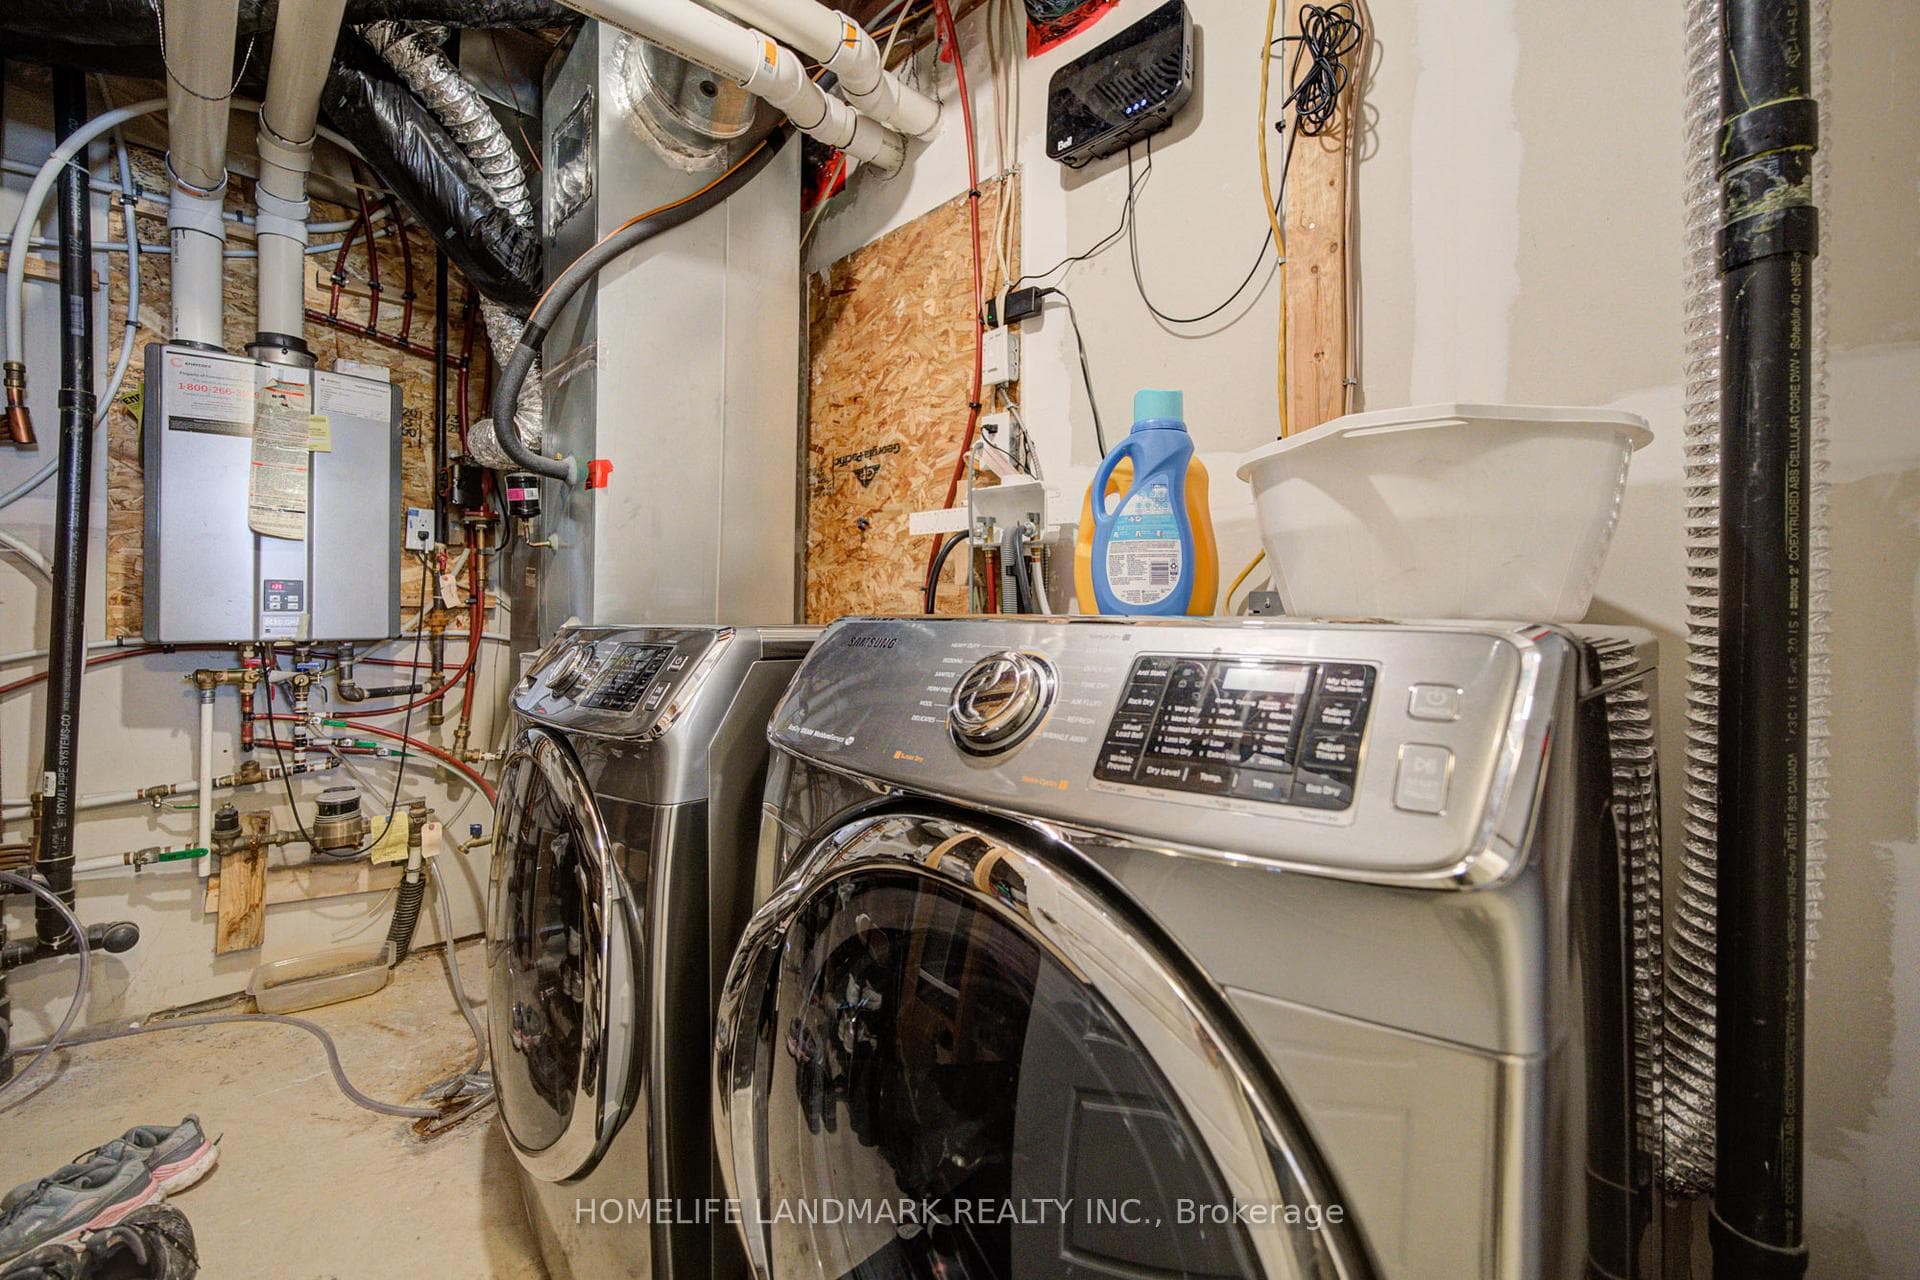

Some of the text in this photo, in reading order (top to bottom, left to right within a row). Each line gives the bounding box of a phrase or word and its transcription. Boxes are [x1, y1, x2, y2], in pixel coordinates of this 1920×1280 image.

[1057, 136, 1073, 151] Bell
[1790, 293, 1801, 306] 40
[1790, 307, 1801, 350] Schedule
[1790, 358, 1801, 383] DWV
[1790, 384, 1801, 413] CORE
[1789, 415, 1800, 468] CELLULAR
[1789, 468, 1800, 490] ABS
[1789, 491, 1800, 561] COEXTRUDED
[848, 636, 898, 649] SAMSUNG
[1128, 697, 1155, 707] Rack Dry
[1322, 706, 1351, 717] Adjust
[1188, 716, 1200, 724] Dry
[1321, 714, 1343, 725] Time
[1116, 730, 1131, 738] Load
[1191, 726, 1204, 736] Dry
[57, 714, 71, 766] SYSTEMS-CO
[1178, 736, 1192, 746] Dry
[1210, 739, 1225, 748] Low
[1180, 748, 1194, 757] Dry
[1316, 742, 1346, 752] Adjust
[1316, 750, 1337, 760] Time
[1106, 762, 1132, 772] Prevent
[1146, 766, 1180, 777] Dry Level
[1788, 753, 1798, 793] CANADA
[57, 767, 69, 786] PIPE
[1252, 778, 1274, 790] Time
[1322, 785, 1342, 797] Dry
[56, 787, 68, 815] ROYAL
